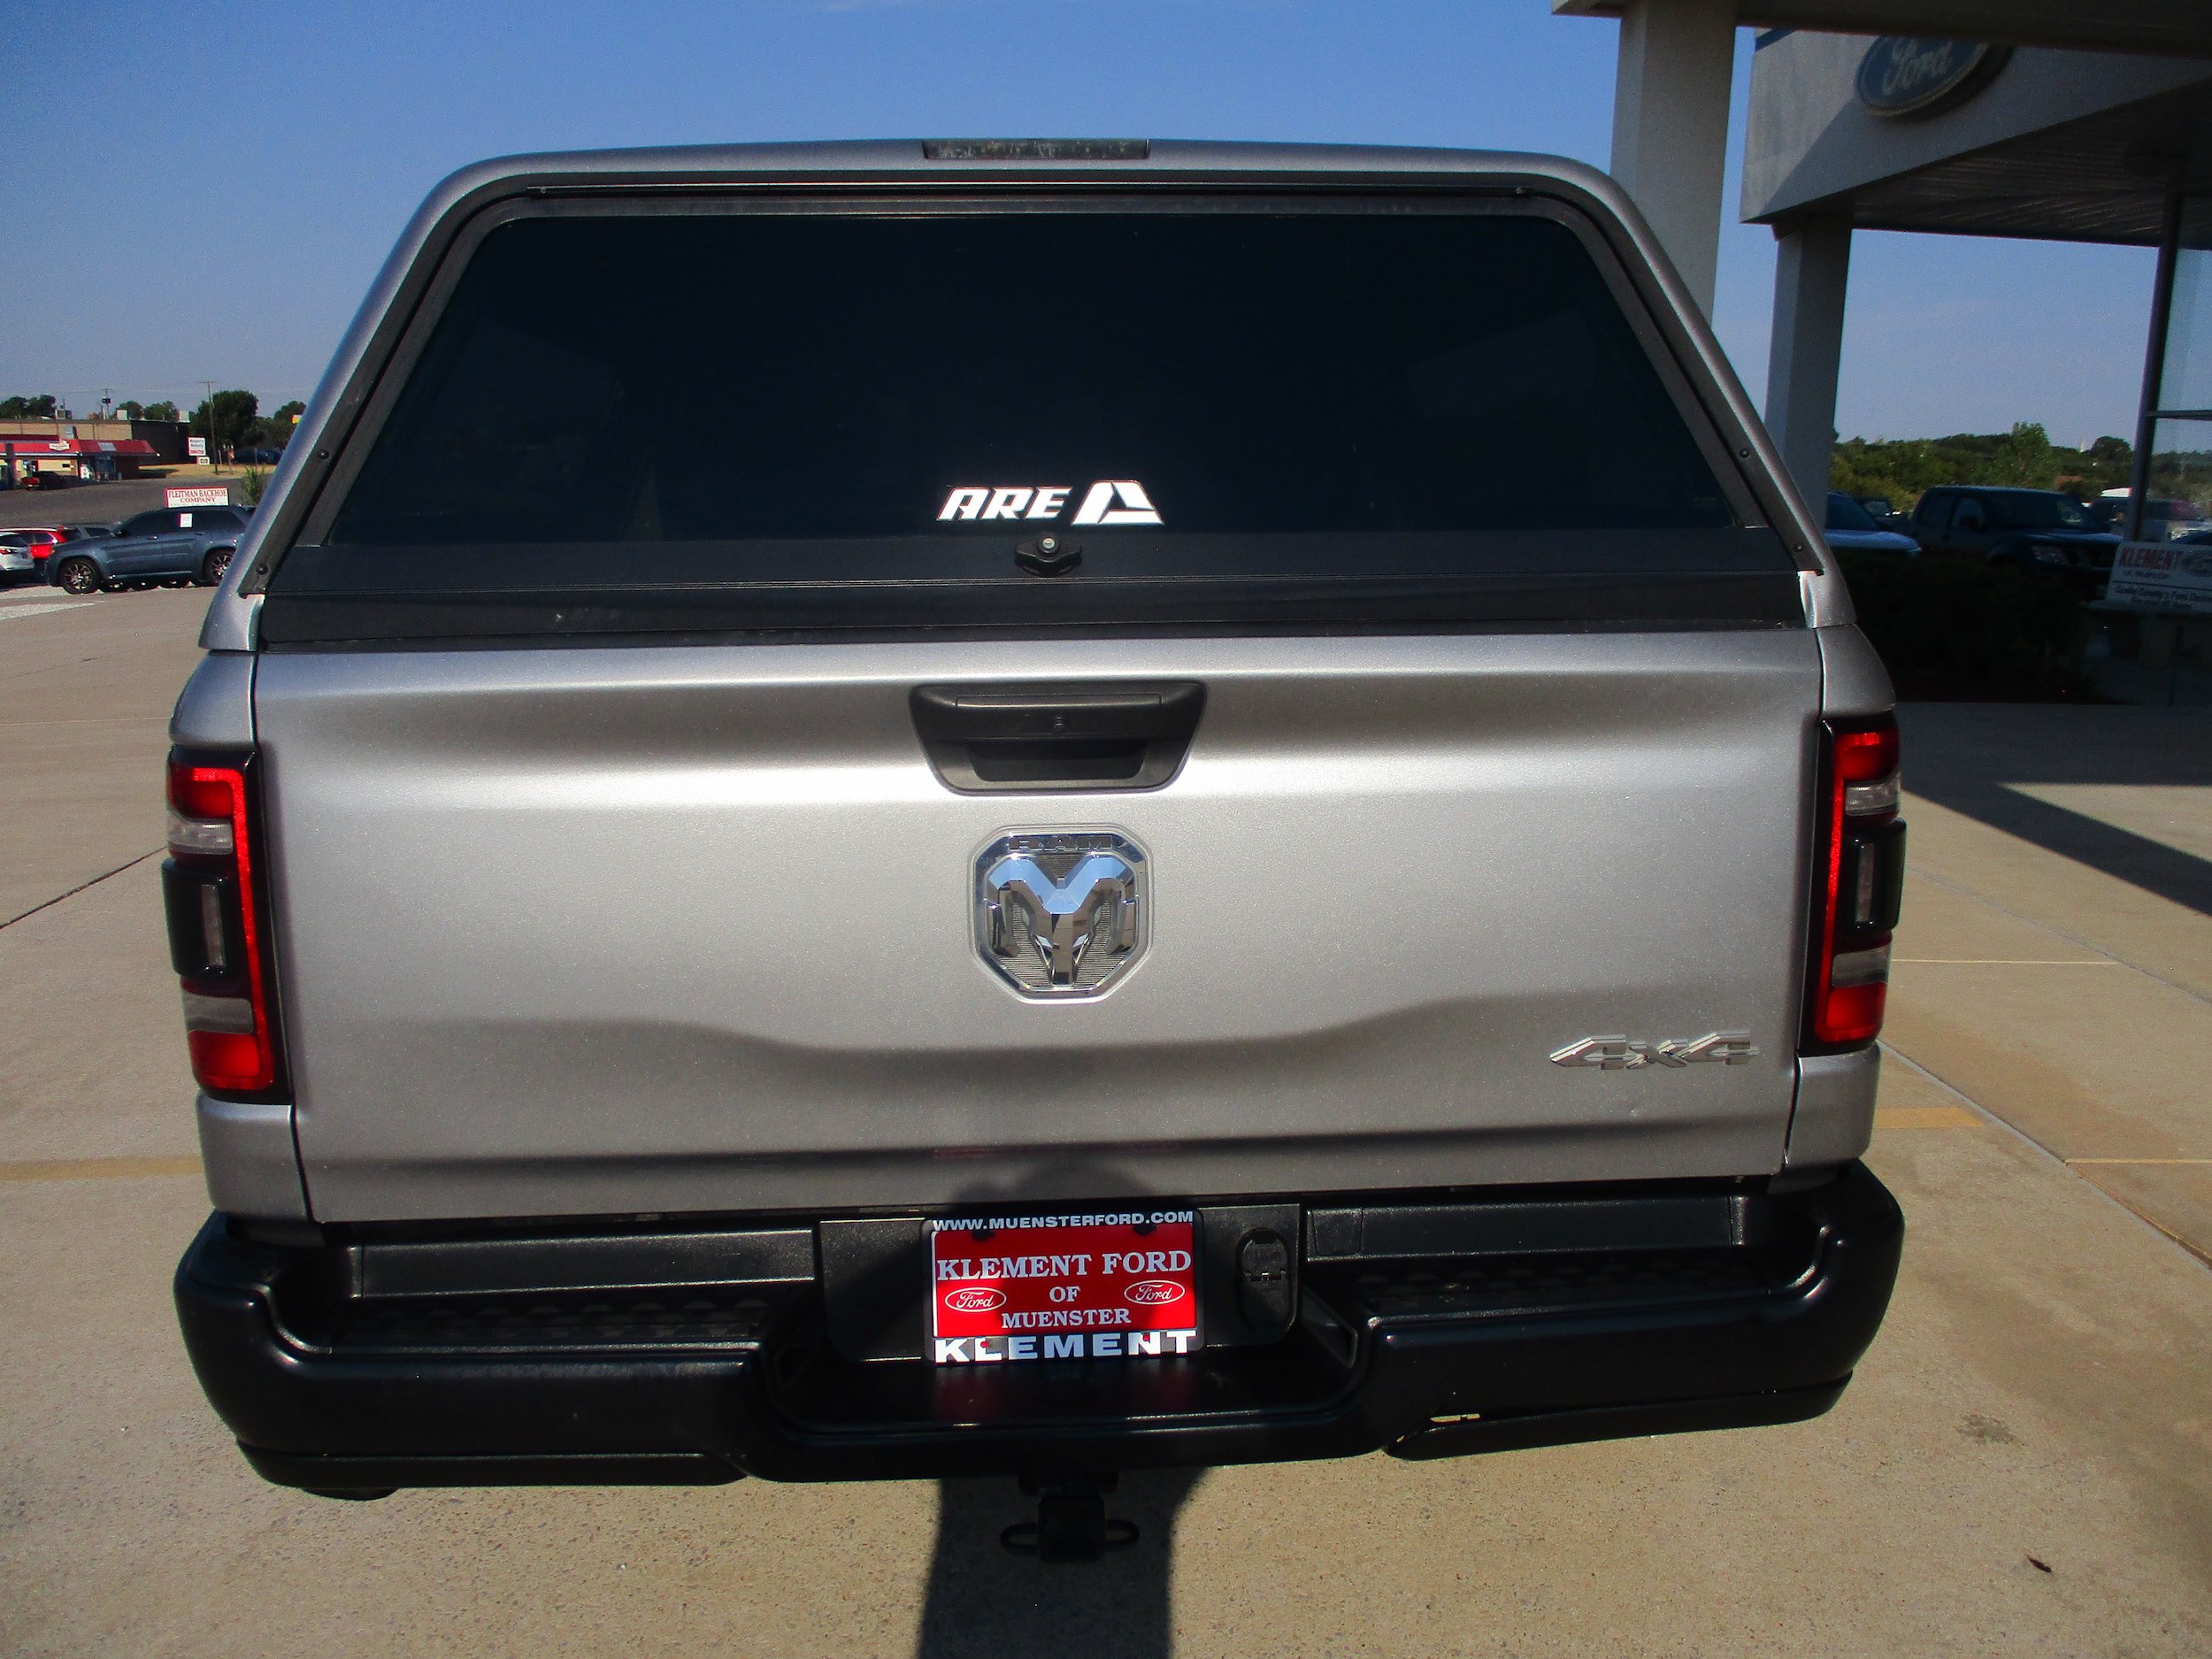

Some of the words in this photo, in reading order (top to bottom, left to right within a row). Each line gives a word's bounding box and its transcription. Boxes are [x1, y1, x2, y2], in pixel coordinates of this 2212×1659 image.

[936, 487, 1072, 521] ARE
[2117, 548, 2184, 571] KLEMENT
[933, 1211, 1194, 1231] WWW.MUENSTERFORD.COM
[937, 1254, 1092, 1281] KLEMENT
[1102, 1250, 1192, 1275] FORD
[956, 1291, 995, 1309] Ford
[1048, 1286, 1081, 1302] OF
[1135, 1283, 1174, 1302] Ford
[1002, 1308, 1132, 1329] MUENSTER
[933, 1330, 1196, 1363] KLEMENT
